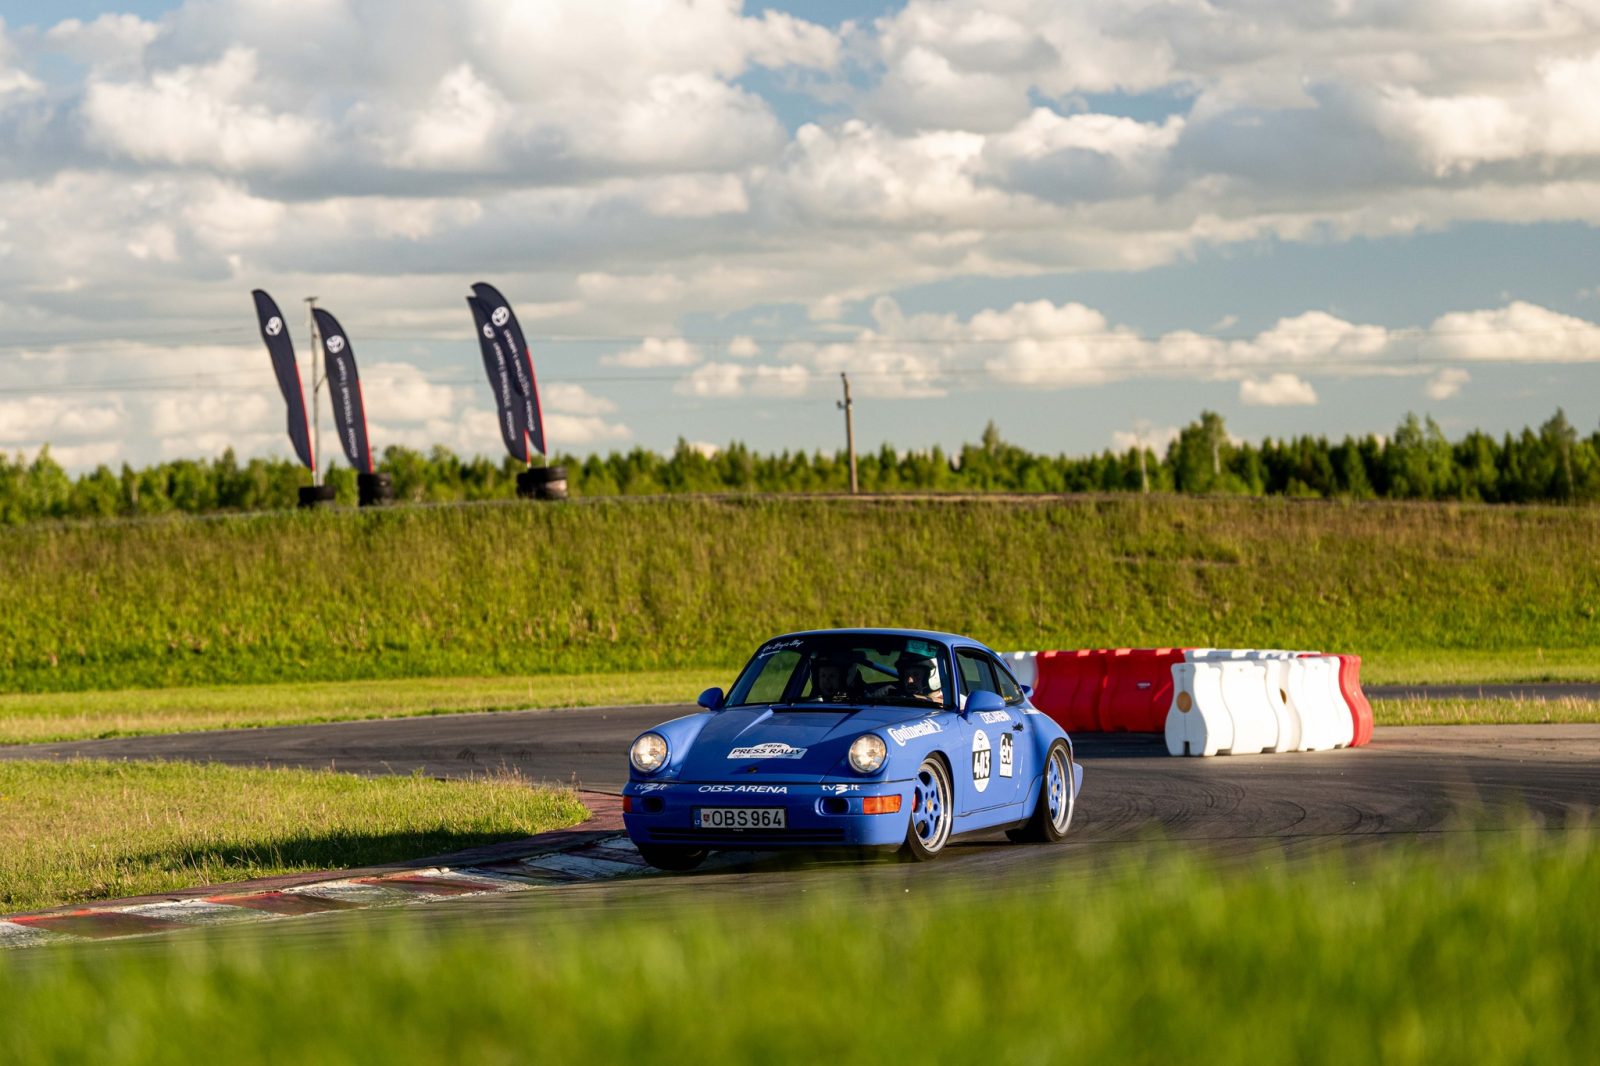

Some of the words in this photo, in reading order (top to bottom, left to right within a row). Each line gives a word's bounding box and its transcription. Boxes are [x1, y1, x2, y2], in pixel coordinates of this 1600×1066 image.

[888, 718, 943, 746] Continental
[974, 750, 990, 778] 403
[698, 784, 734, 792] OBS
[736, 785, 788, 794] ARENA
[822, 784, 860, 795] tv3.lt
